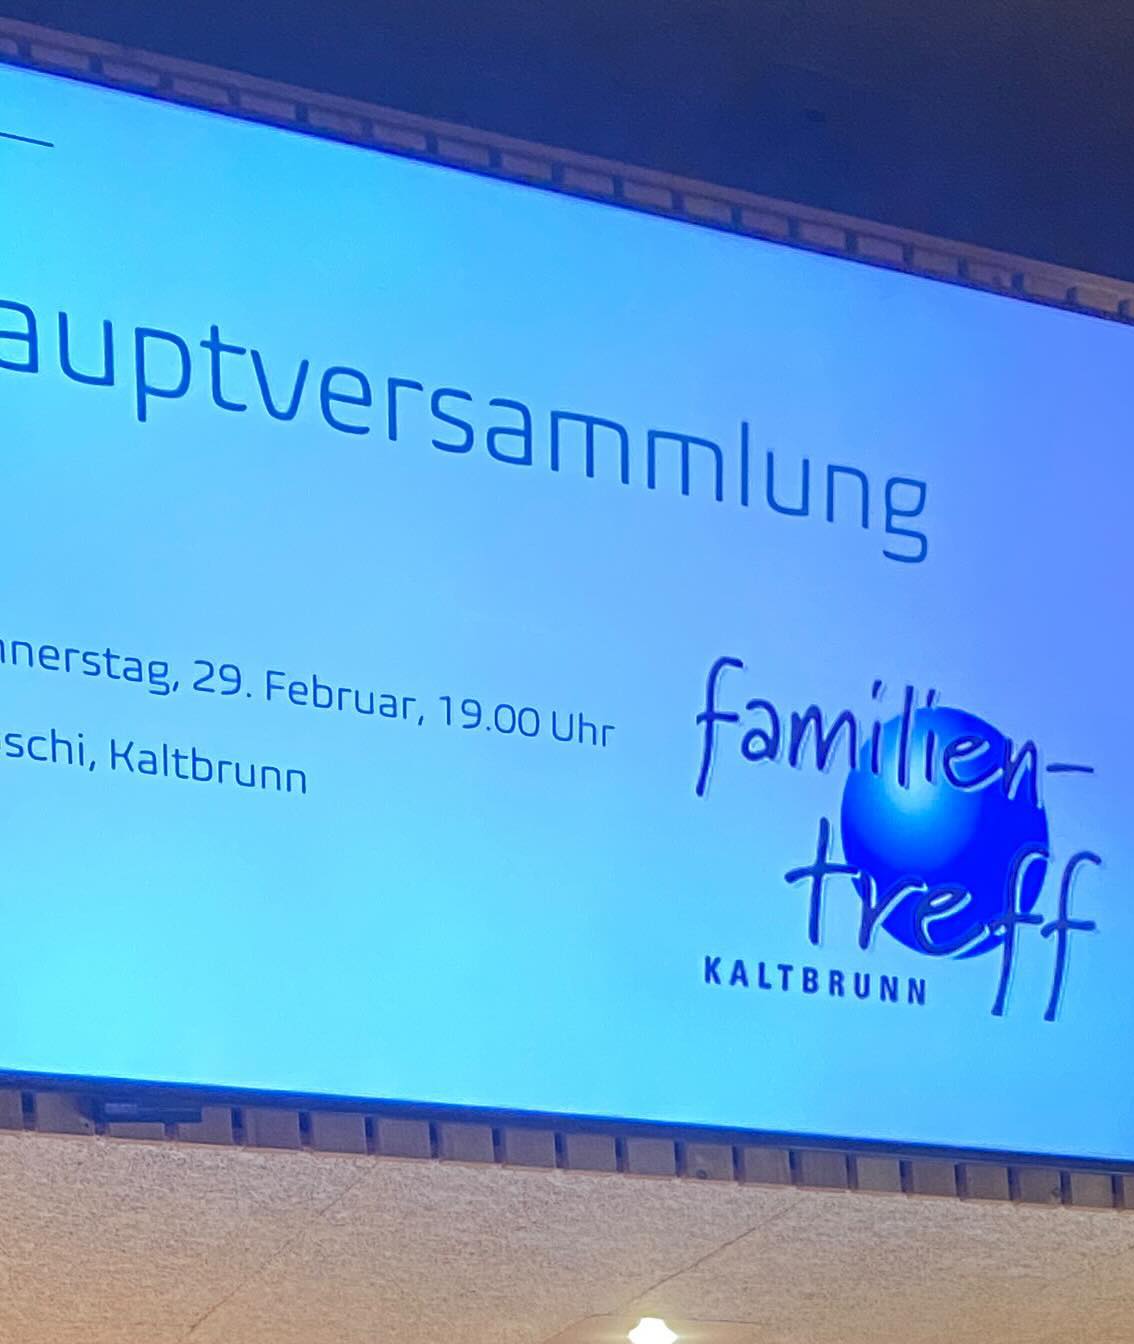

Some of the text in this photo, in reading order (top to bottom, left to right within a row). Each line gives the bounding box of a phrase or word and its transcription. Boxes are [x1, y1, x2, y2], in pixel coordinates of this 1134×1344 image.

[192, 658, 252, 698] 29.
[265, 669, 425, 727] Februar,
[439, 694, 541, 738] 19.00
[551, 709, 617, 748] Uhr
[695, 655, 1096, 810] familien-
[3, 727, 308, 795] schi, Kaltbrunn
[783, 815, 1102, 1022] treff
[703, 954, 927, 1006] KALTBRUNN
